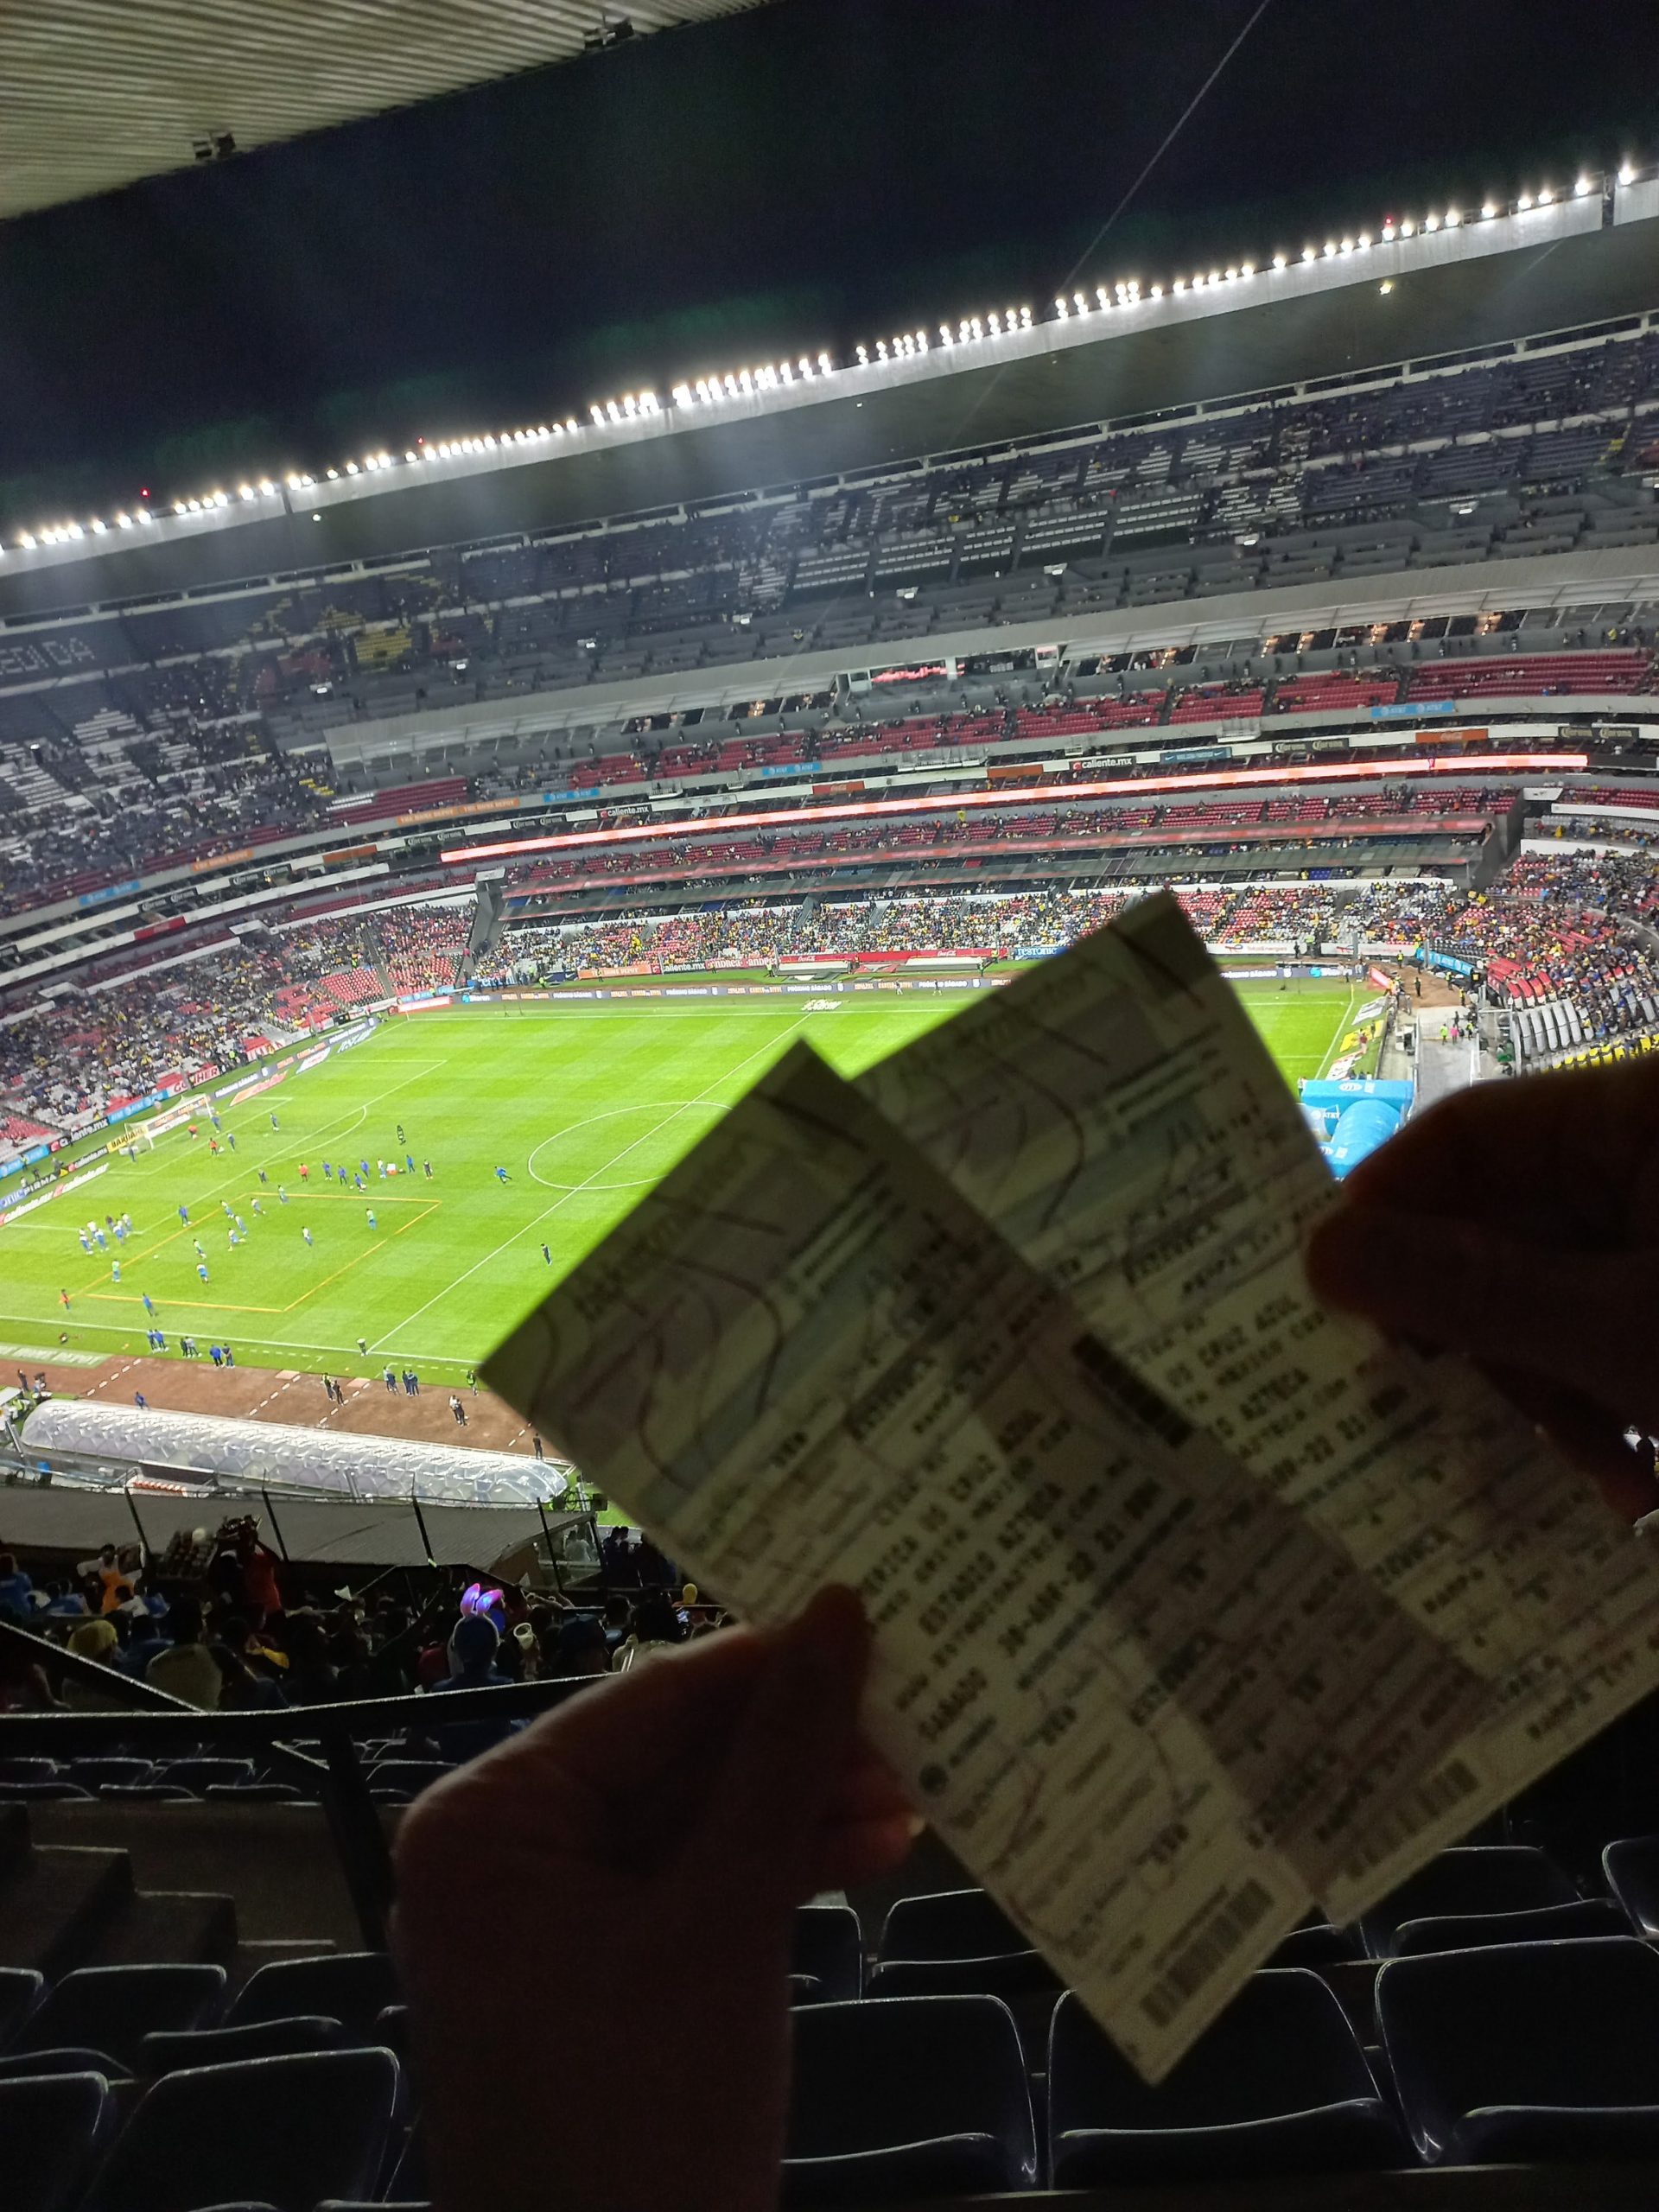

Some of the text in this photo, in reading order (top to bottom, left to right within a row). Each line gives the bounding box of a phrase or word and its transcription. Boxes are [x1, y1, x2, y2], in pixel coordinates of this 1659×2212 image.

[1082, 757, 1133, 769] caliente.mx
[607, 806, 649, 817] caliente.mx
[174, 1067, 219, 1092] GOHER
[60, 1118, 108, 1147] caiente.mx
[23, 1173, 57, 1193] PIRMA
[1193, 1320, 1252, 1371] CRUZ
[1249, 1287, 1302, 1335] AZUL
[1235, 1359, 1313, 1426] AZTECA
[943, 1448, 1000, 1505] CRUZ
[990, 1399, 1046, 1455] AZUL
[912, 1546, 1000, 1641] ESTADIO
[990, 1474, 1066, 1554] AZTECA
[911, 1662, 992, 1747] SABADO
